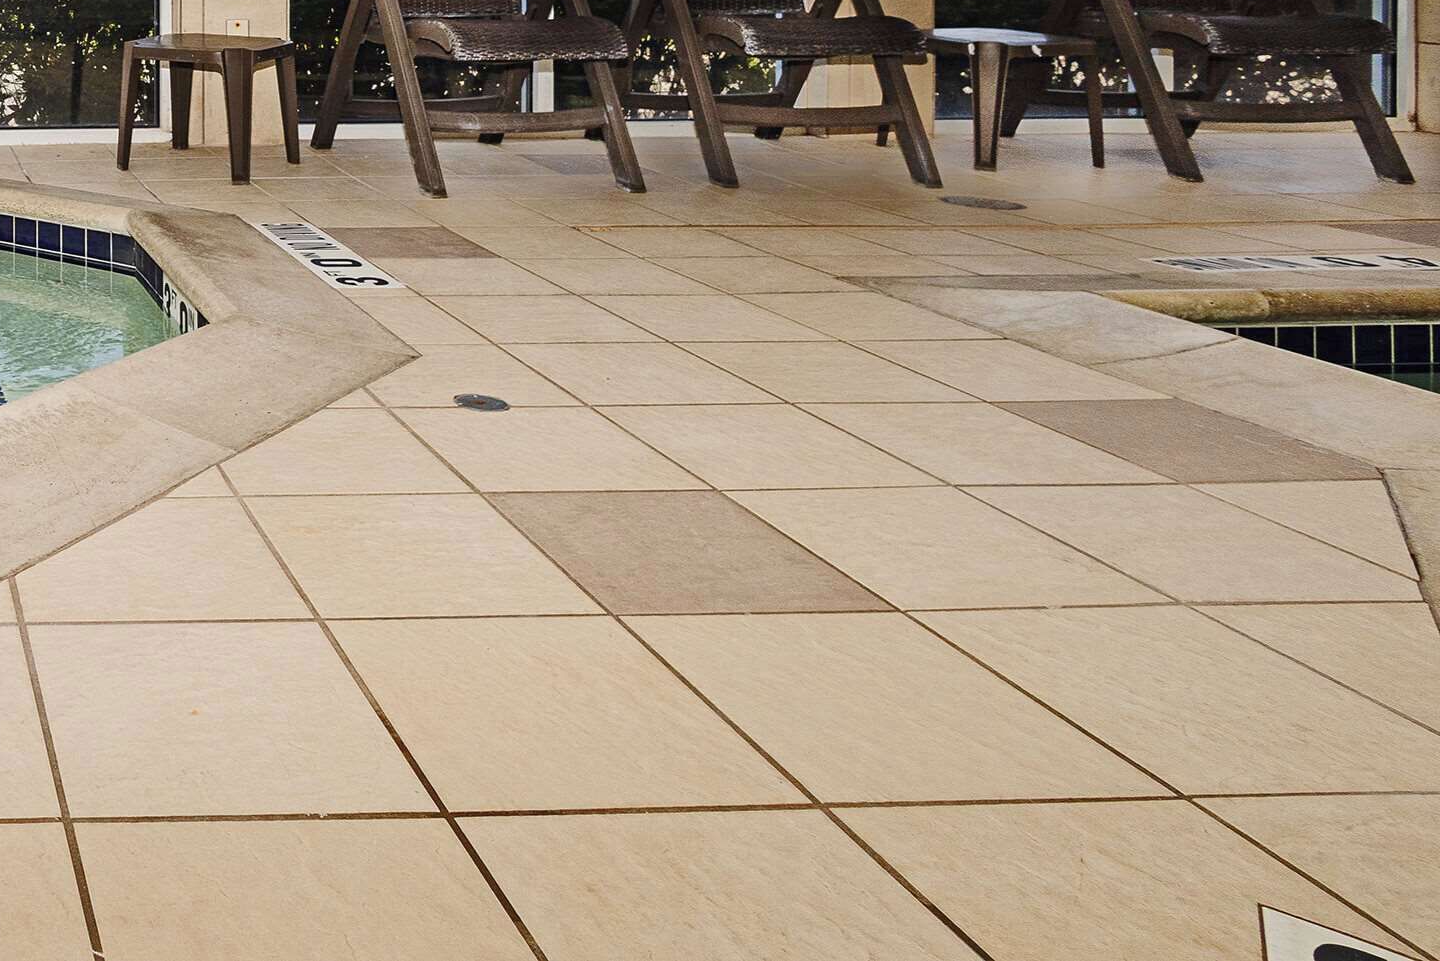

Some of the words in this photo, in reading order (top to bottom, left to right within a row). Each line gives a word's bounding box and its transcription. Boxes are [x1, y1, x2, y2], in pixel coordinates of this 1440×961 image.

[310, 258, 362, 267] 0
[335, 277, 389, 286] 3
[164, 283, 171, 318] 3
